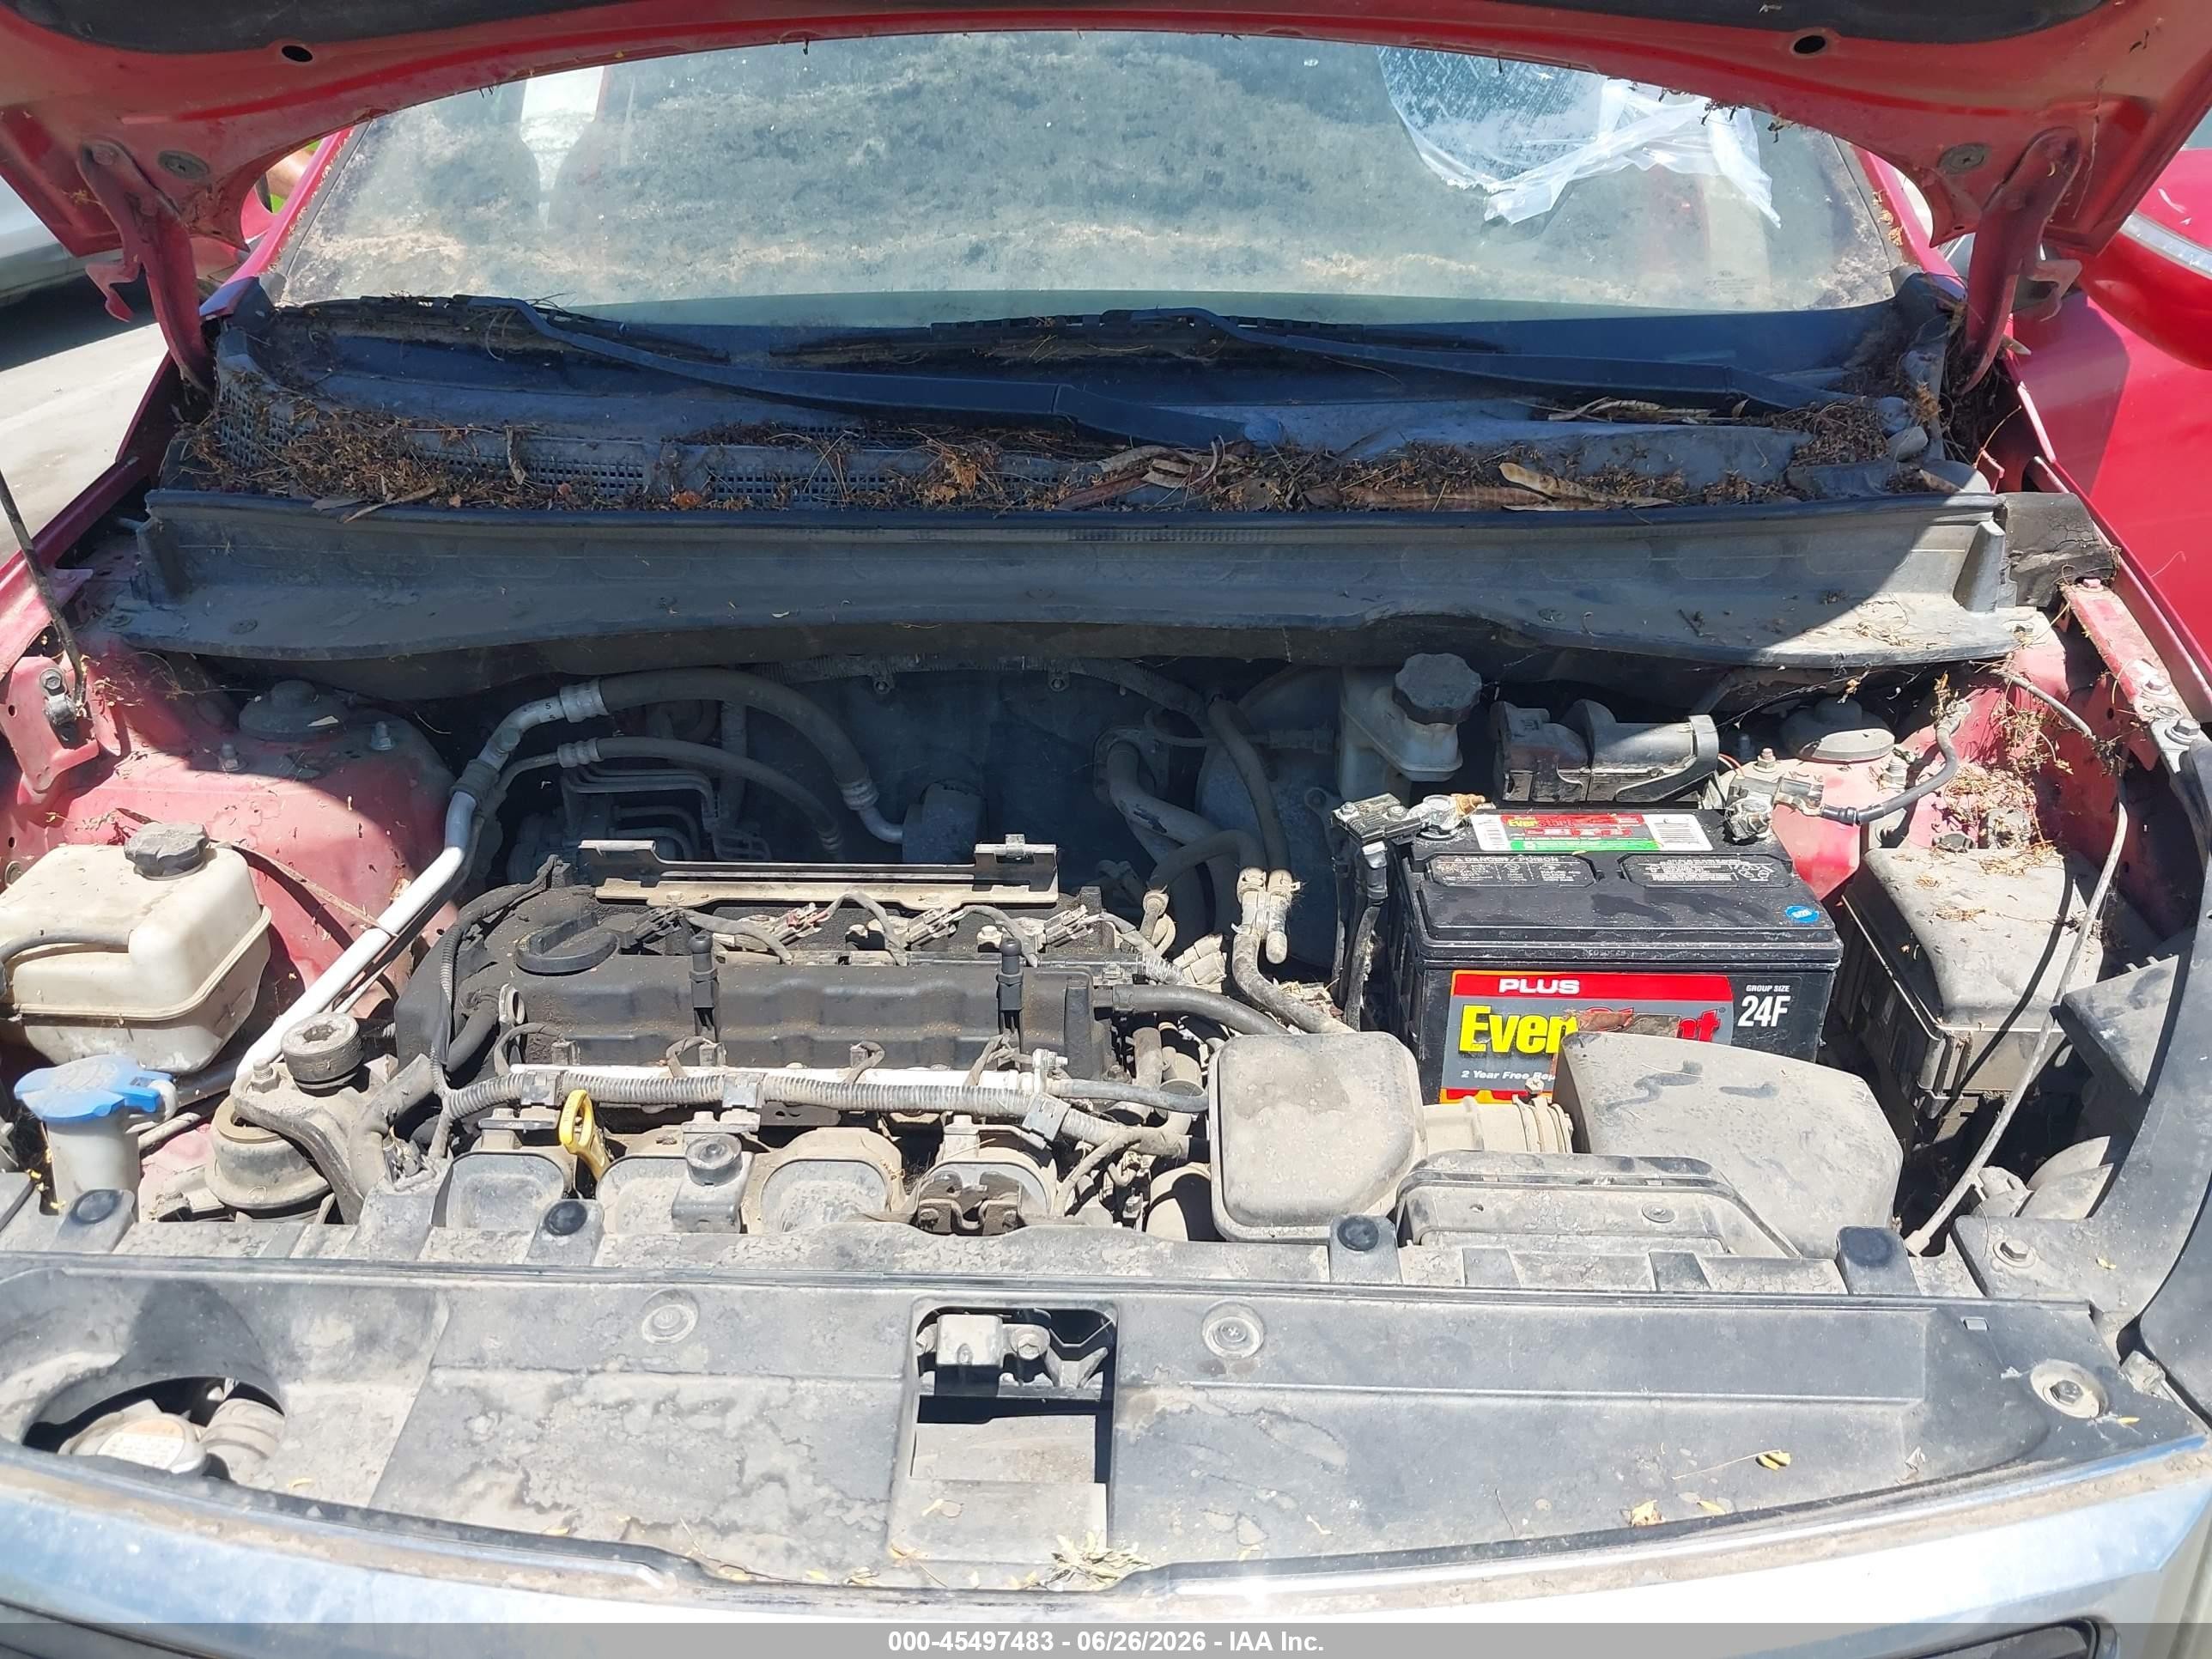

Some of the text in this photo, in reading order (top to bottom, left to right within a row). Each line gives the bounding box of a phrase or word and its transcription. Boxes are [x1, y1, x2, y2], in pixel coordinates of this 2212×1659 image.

[1498, 978, 1580, 994] PLUS
[1746, 984, 1772, 993] GROUP
[1738, 994, 1791, 1027] 24F
[1461, 1070, 1470, 1079] 2
[1474, 1070, 1499, 1079] Year
[1502, 1071, 1530, 1079] Free
